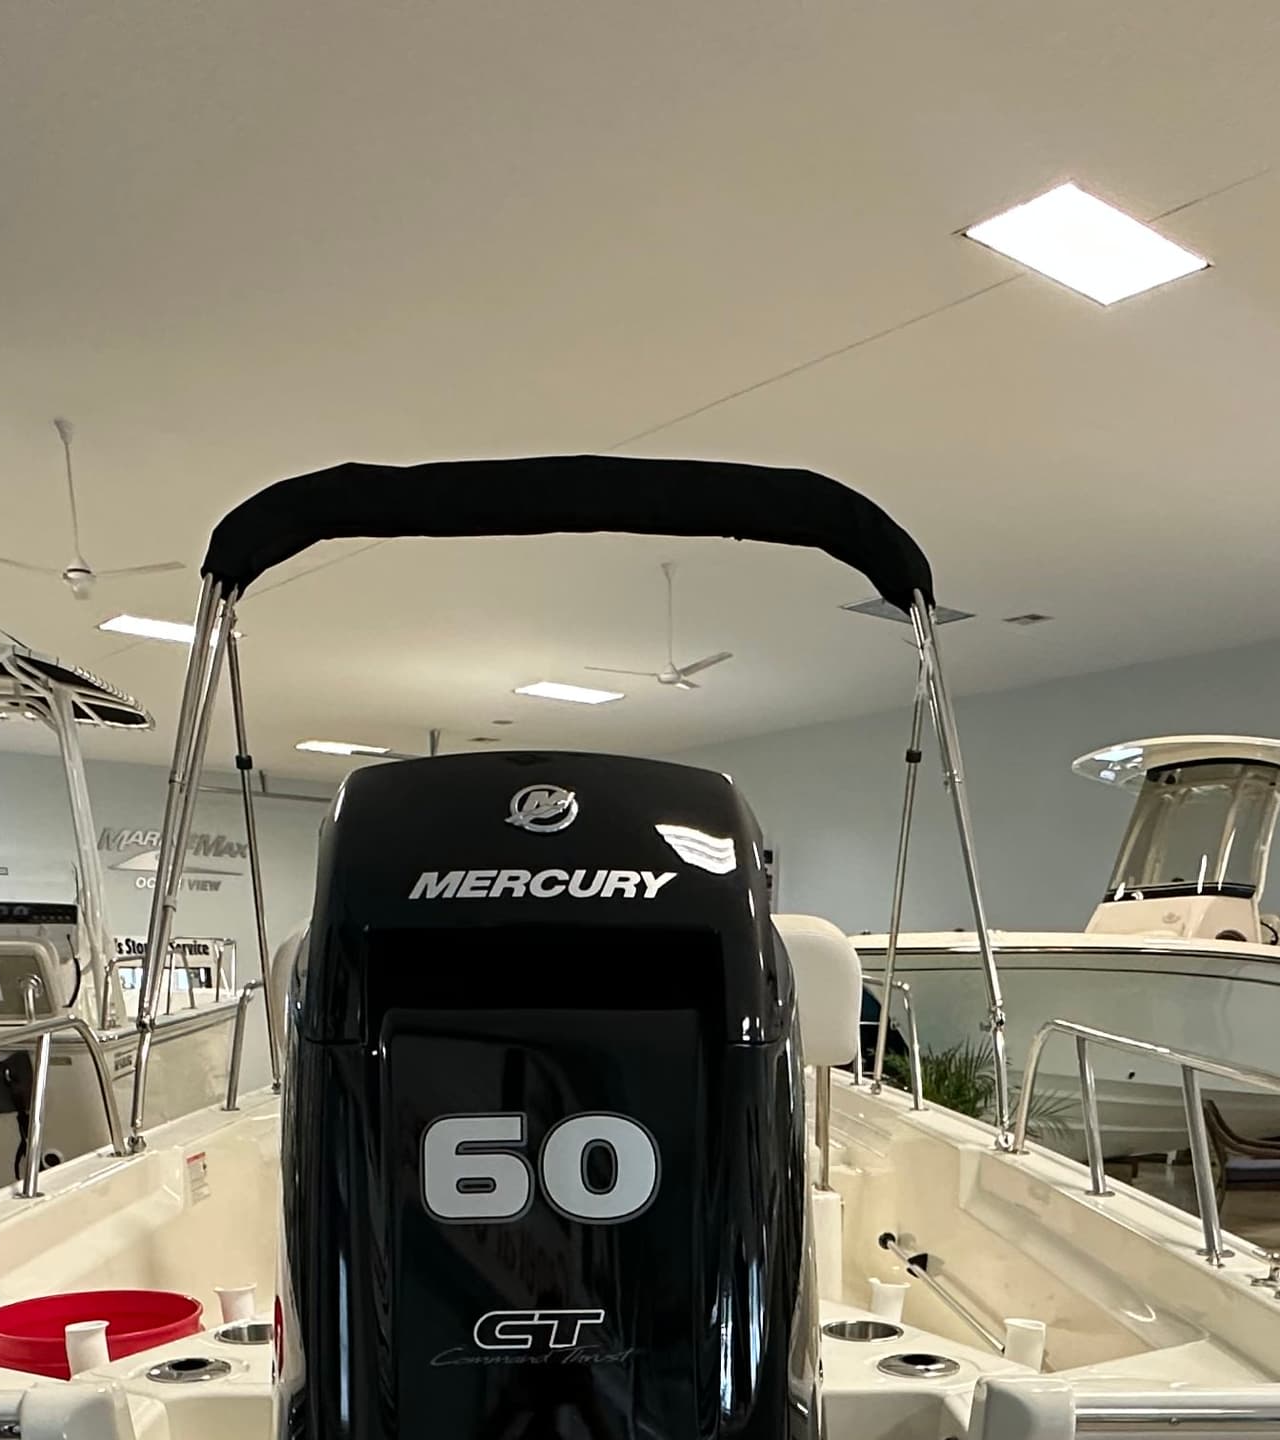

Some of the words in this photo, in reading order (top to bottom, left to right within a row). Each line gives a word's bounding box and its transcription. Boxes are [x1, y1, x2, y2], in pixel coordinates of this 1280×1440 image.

[188, 879, 222, 891] VIEW
[408, 869, 678, 900] MERCURY
[420, 1111, 662, 1225] 60
[473, 1310, 605, 1349] CT
[430, 1347, 553, 1366] Command
[554, 1344, 635, 1365] Thrust
